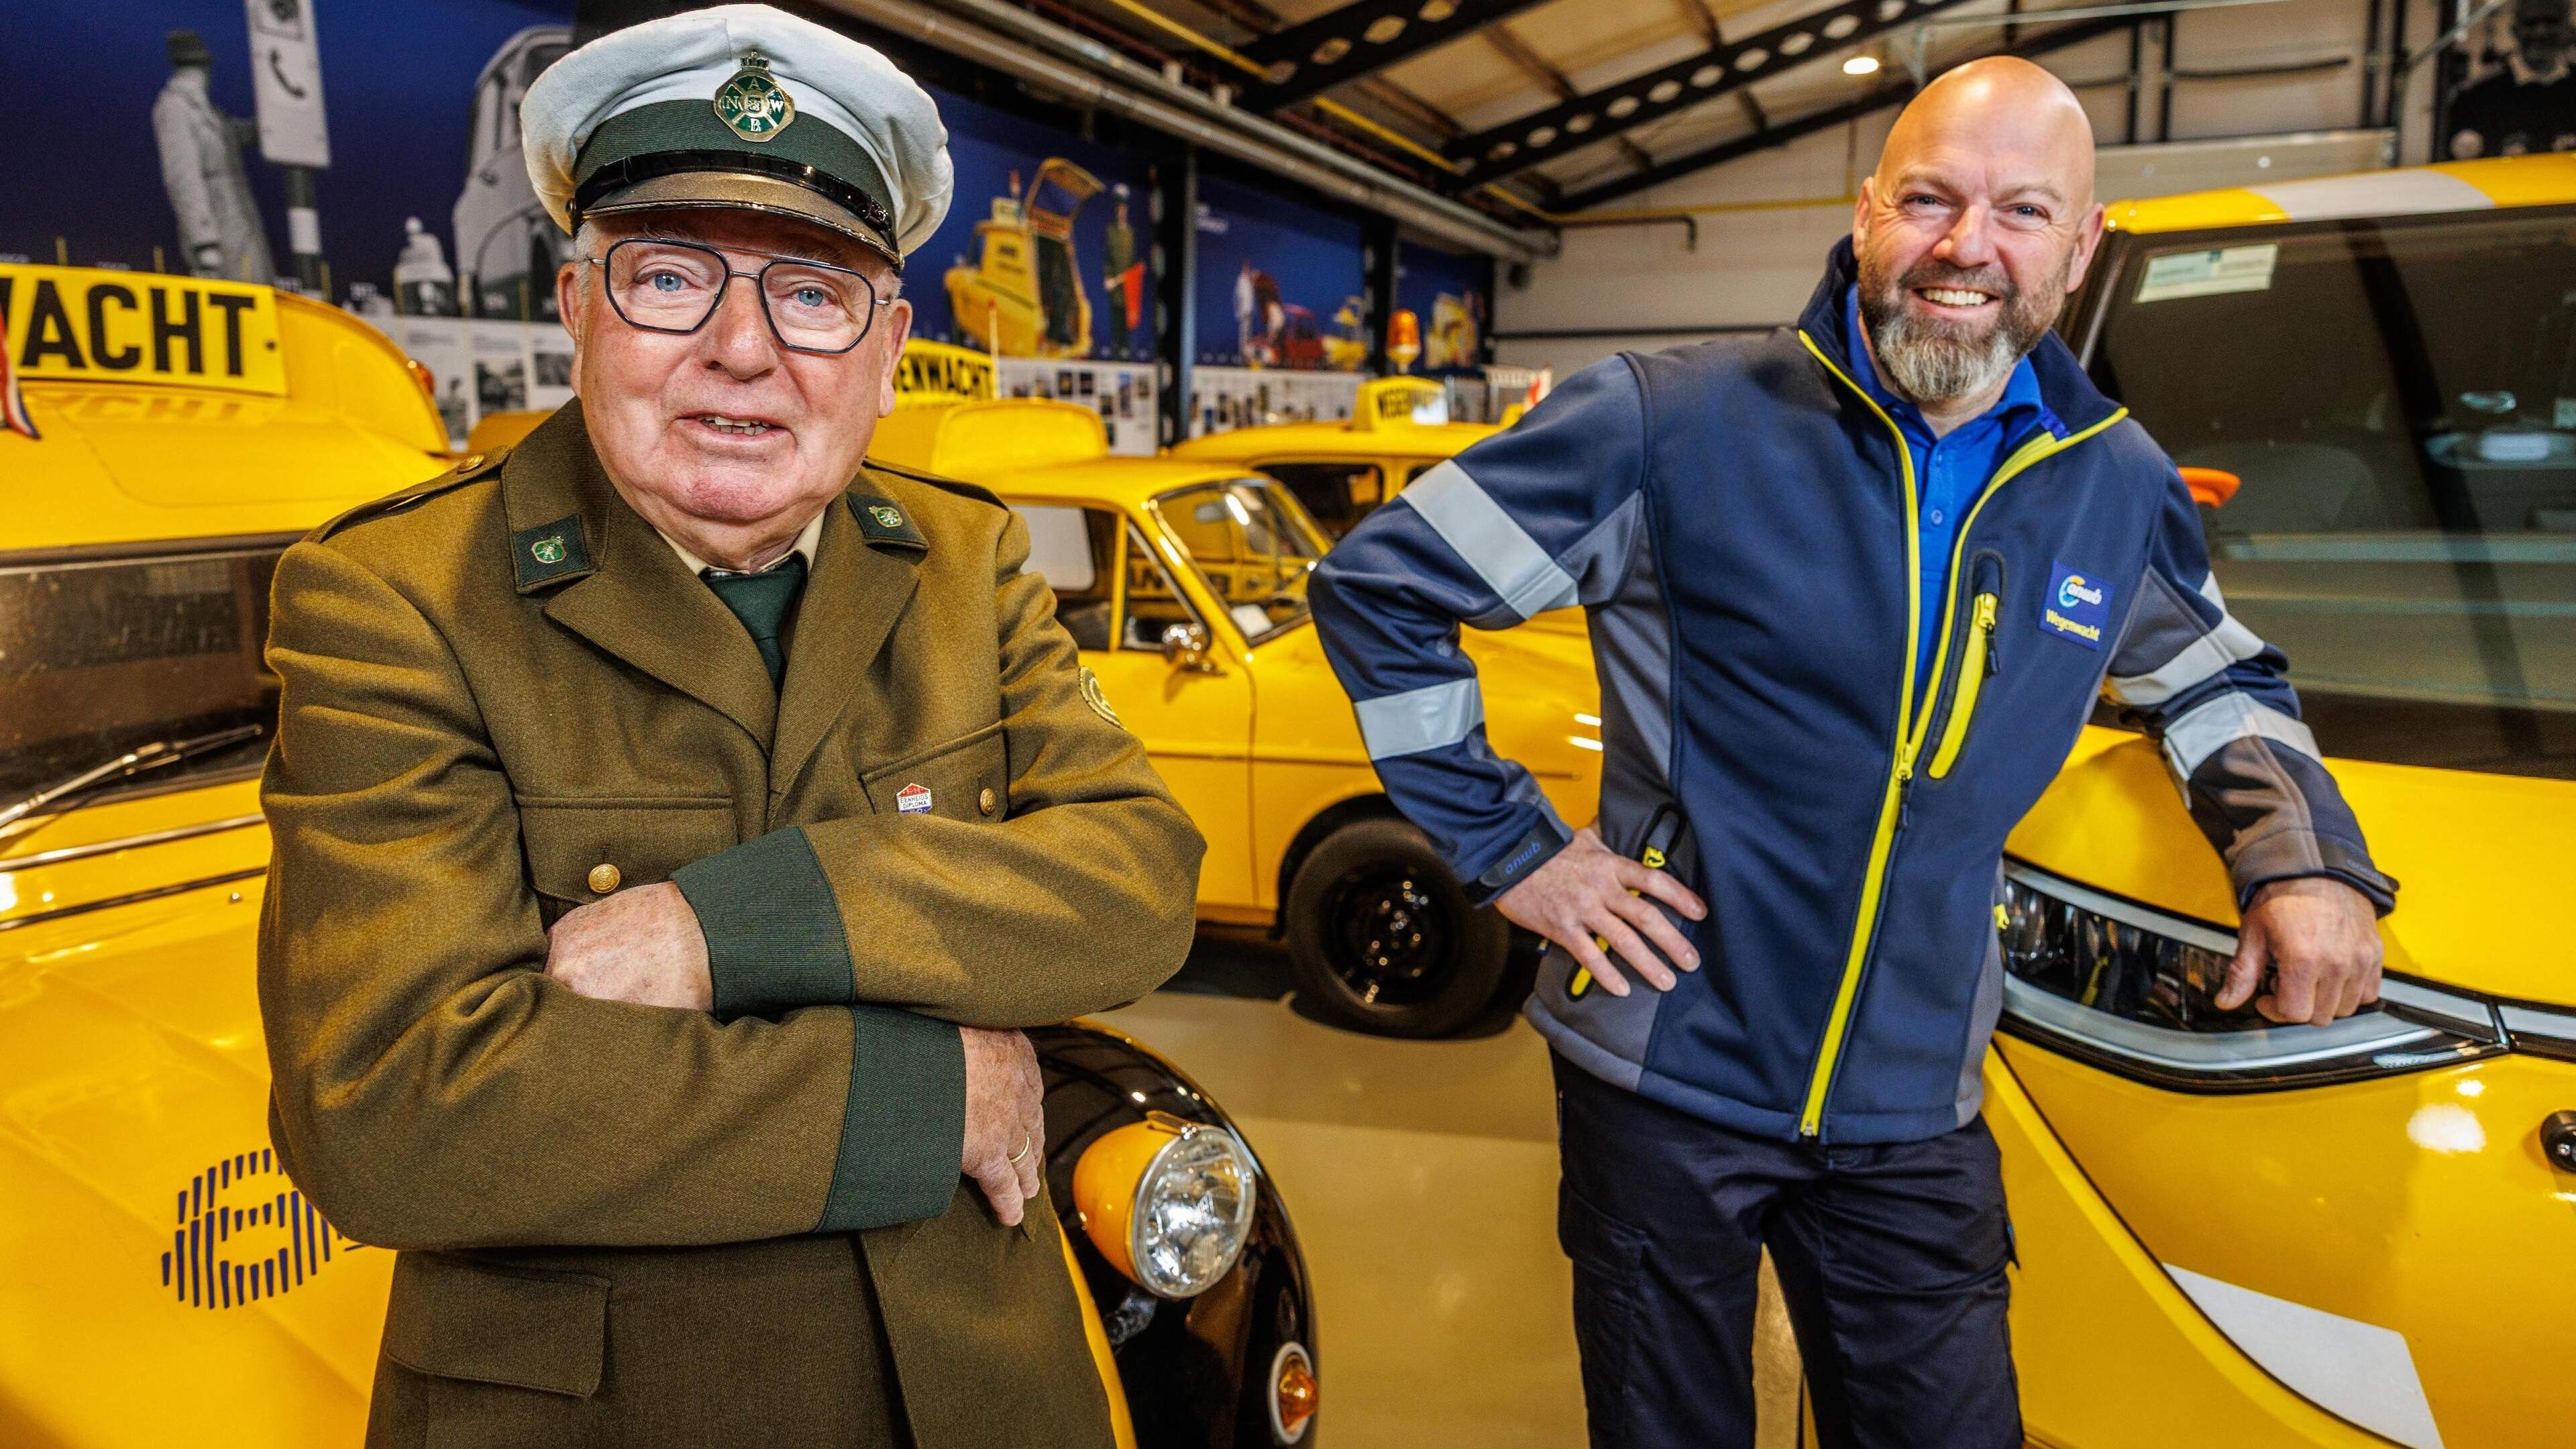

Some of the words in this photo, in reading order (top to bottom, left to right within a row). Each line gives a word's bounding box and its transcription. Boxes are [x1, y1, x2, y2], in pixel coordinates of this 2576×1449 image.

[2067, 583, 2102, 605] anwb
[2046, 608, 2100, 641] Wegenwacht
[903, 800, 927, 809] DIPLOMA
